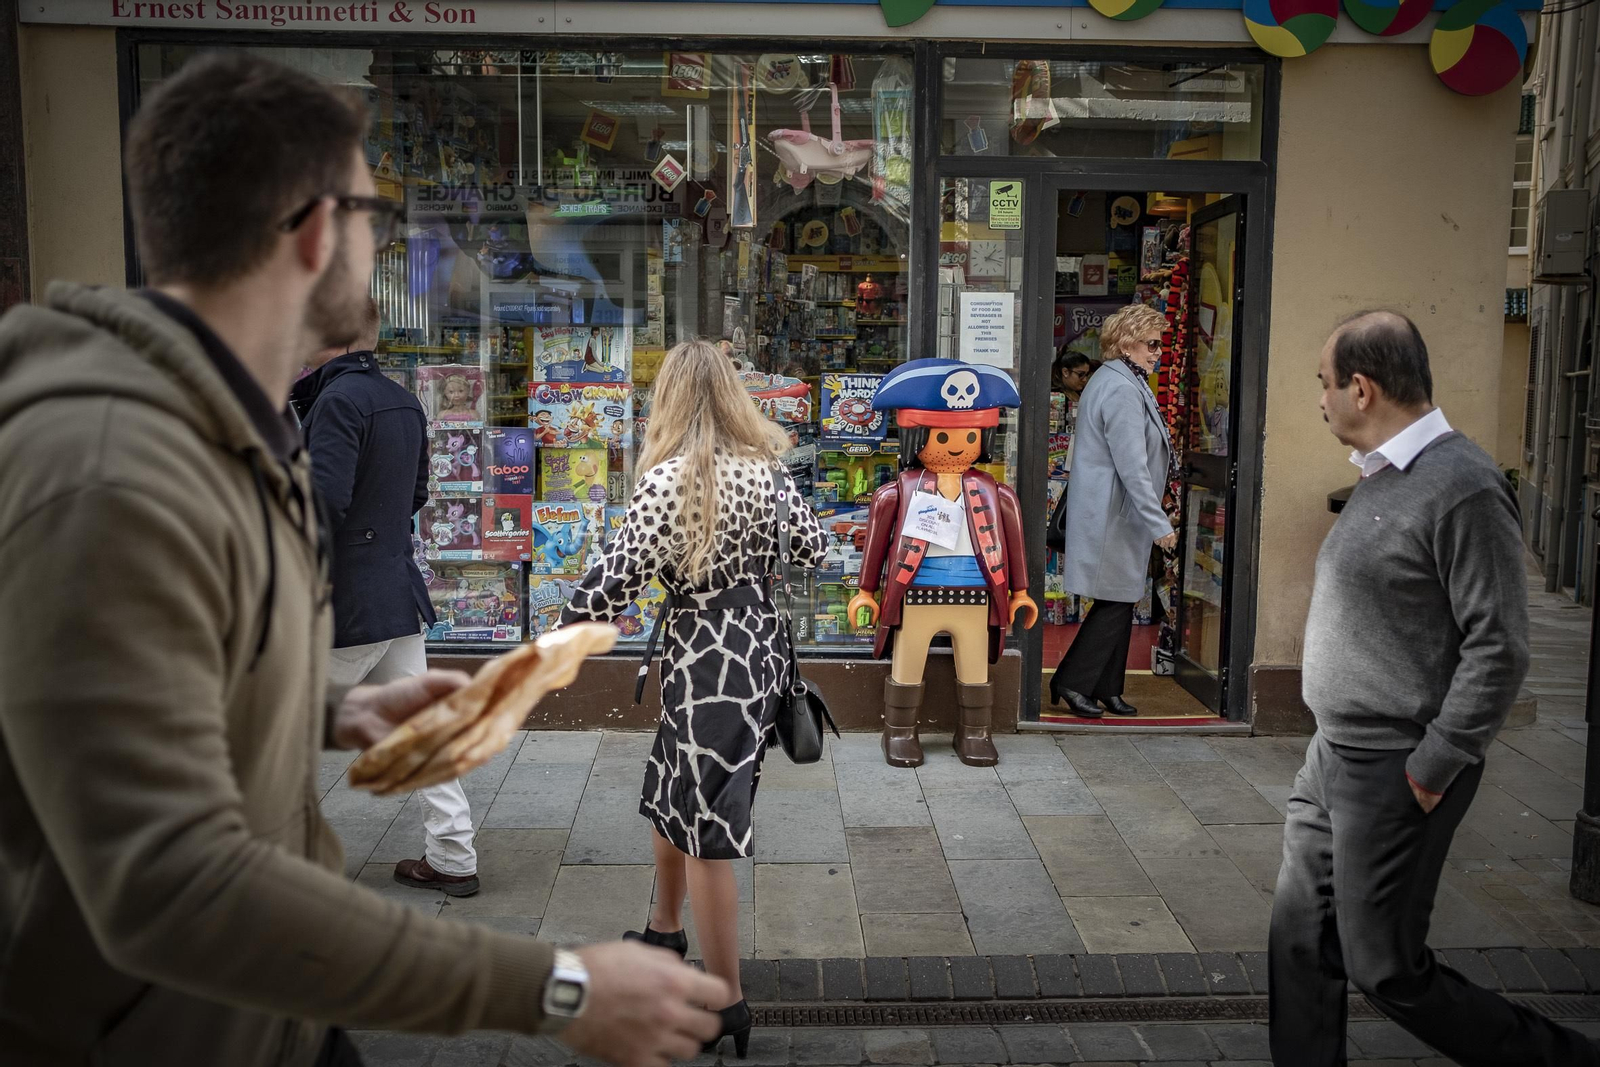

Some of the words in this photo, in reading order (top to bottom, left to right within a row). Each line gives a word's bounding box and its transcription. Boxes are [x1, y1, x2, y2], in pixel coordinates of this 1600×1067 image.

[112, 0, 207, 19] Ernest
[216, 0, 379, 27] Sanguinetti
[389, 1, 414, 23] &
[424, 2, 477, 24] Son
[671, 64, 703, 80] LEGO
[591, 122, 611, 135] LEGO
[661, 167, 677, 181] LEGO
[992, 199, 1019, 207] CCTV
[836, 376, 882, 389] THINK
[536, 384, 583, 405] CHOW
[486, 465, 529, 477] Taboo
[536, 507, 581, 524] Elefun
[818, 509, 835, 518] NERF
[531, 586, 561, 603] Elly
[533, 597, 563, 610] Fountain
[540, 605, 559, 614] GAME
